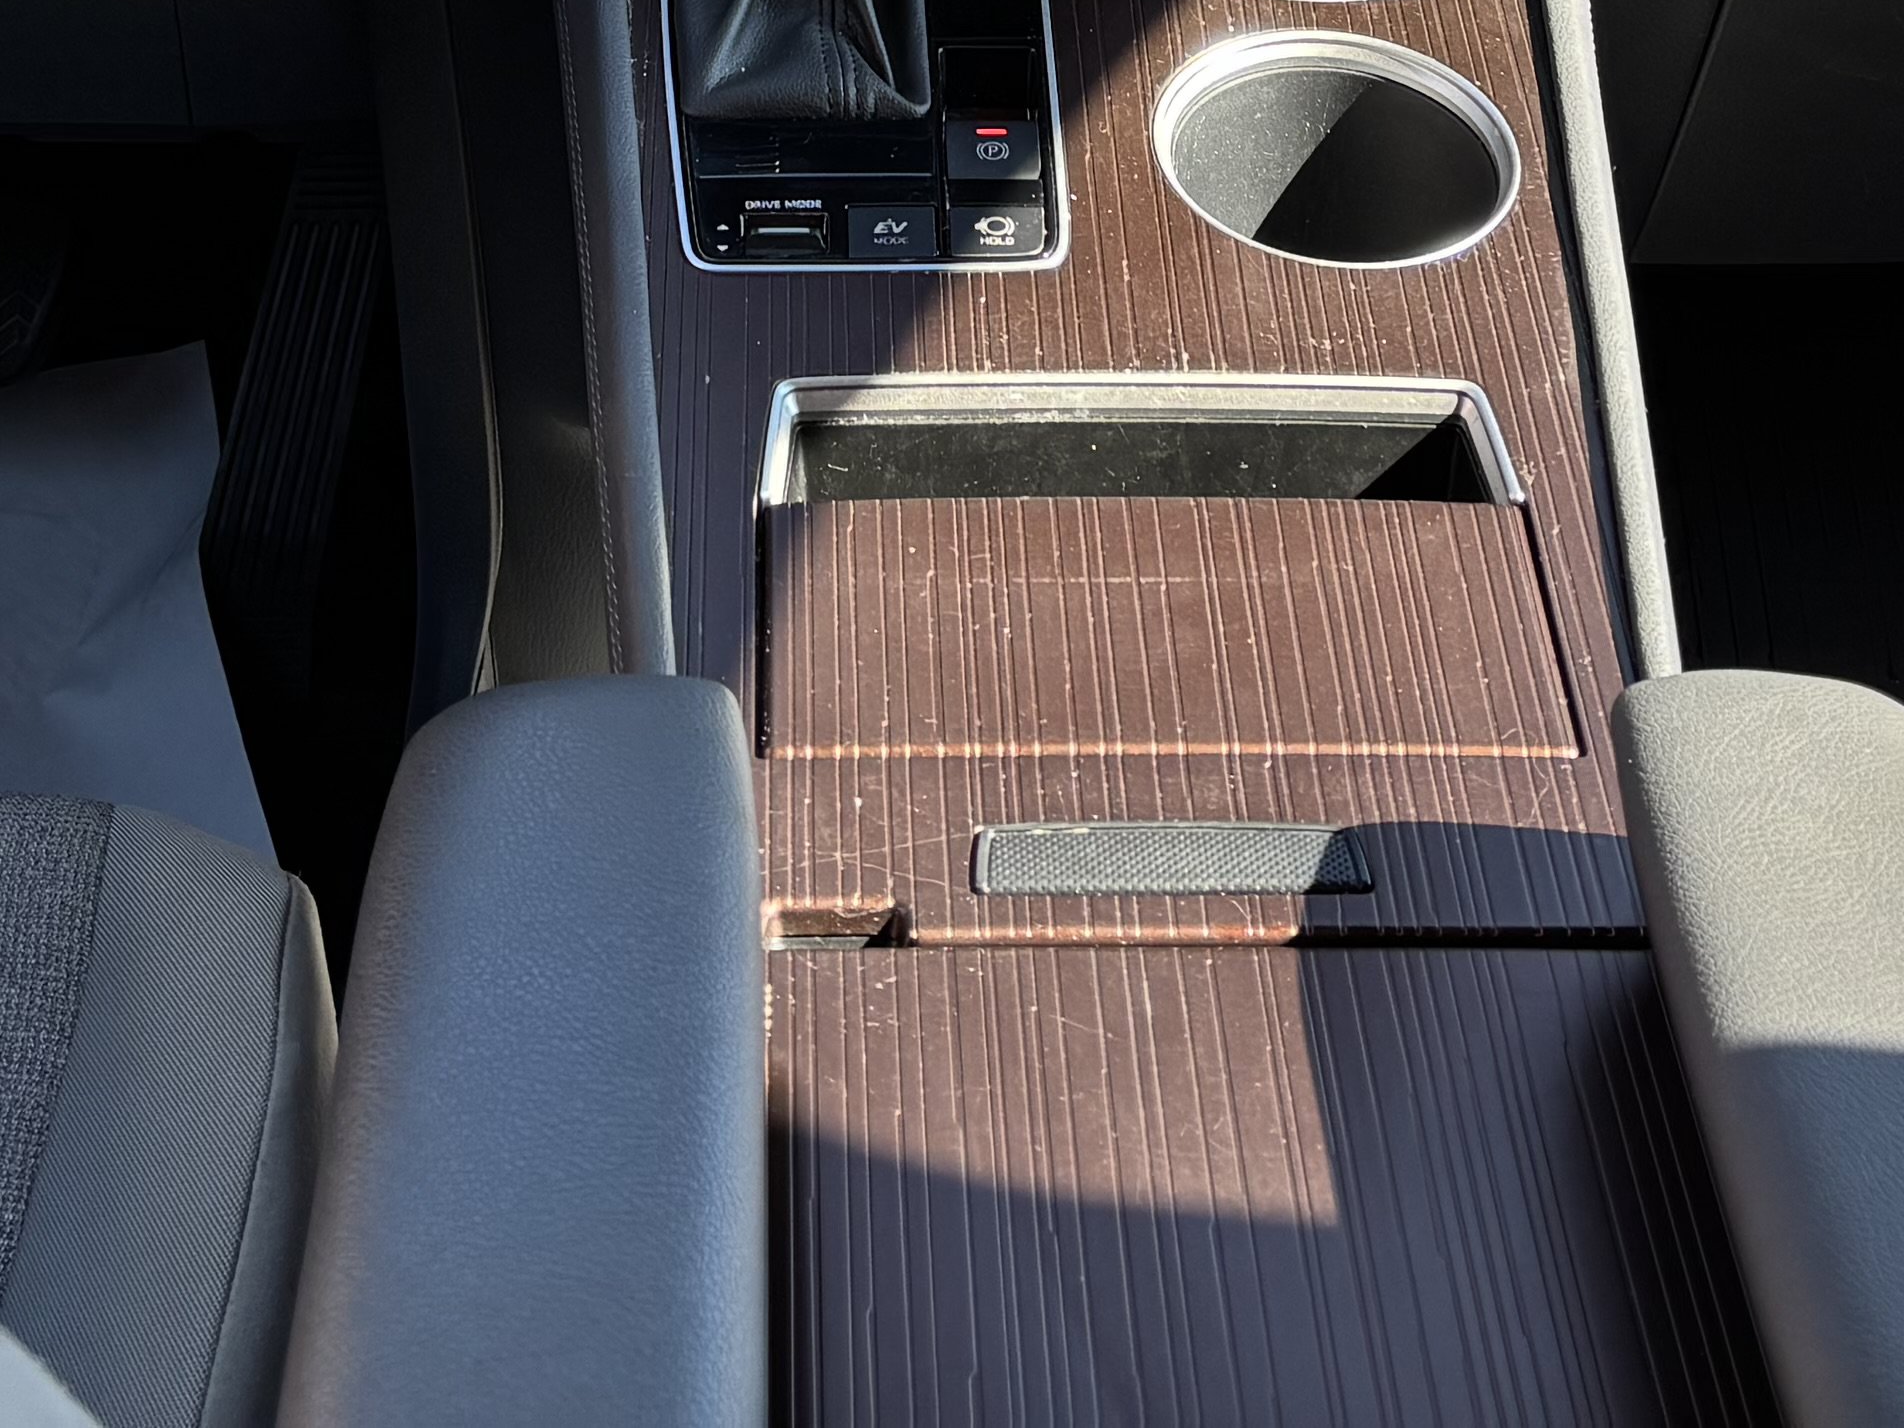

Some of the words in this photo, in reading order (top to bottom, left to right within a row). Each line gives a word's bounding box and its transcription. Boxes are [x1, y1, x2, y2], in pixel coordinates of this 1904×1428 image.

[744, 199, 781, 210] DRIVE
[784, 199, 823, 209] MODE
[873, 220, 909, 234] EV
[979, 236, 1015, 246] HOLD
